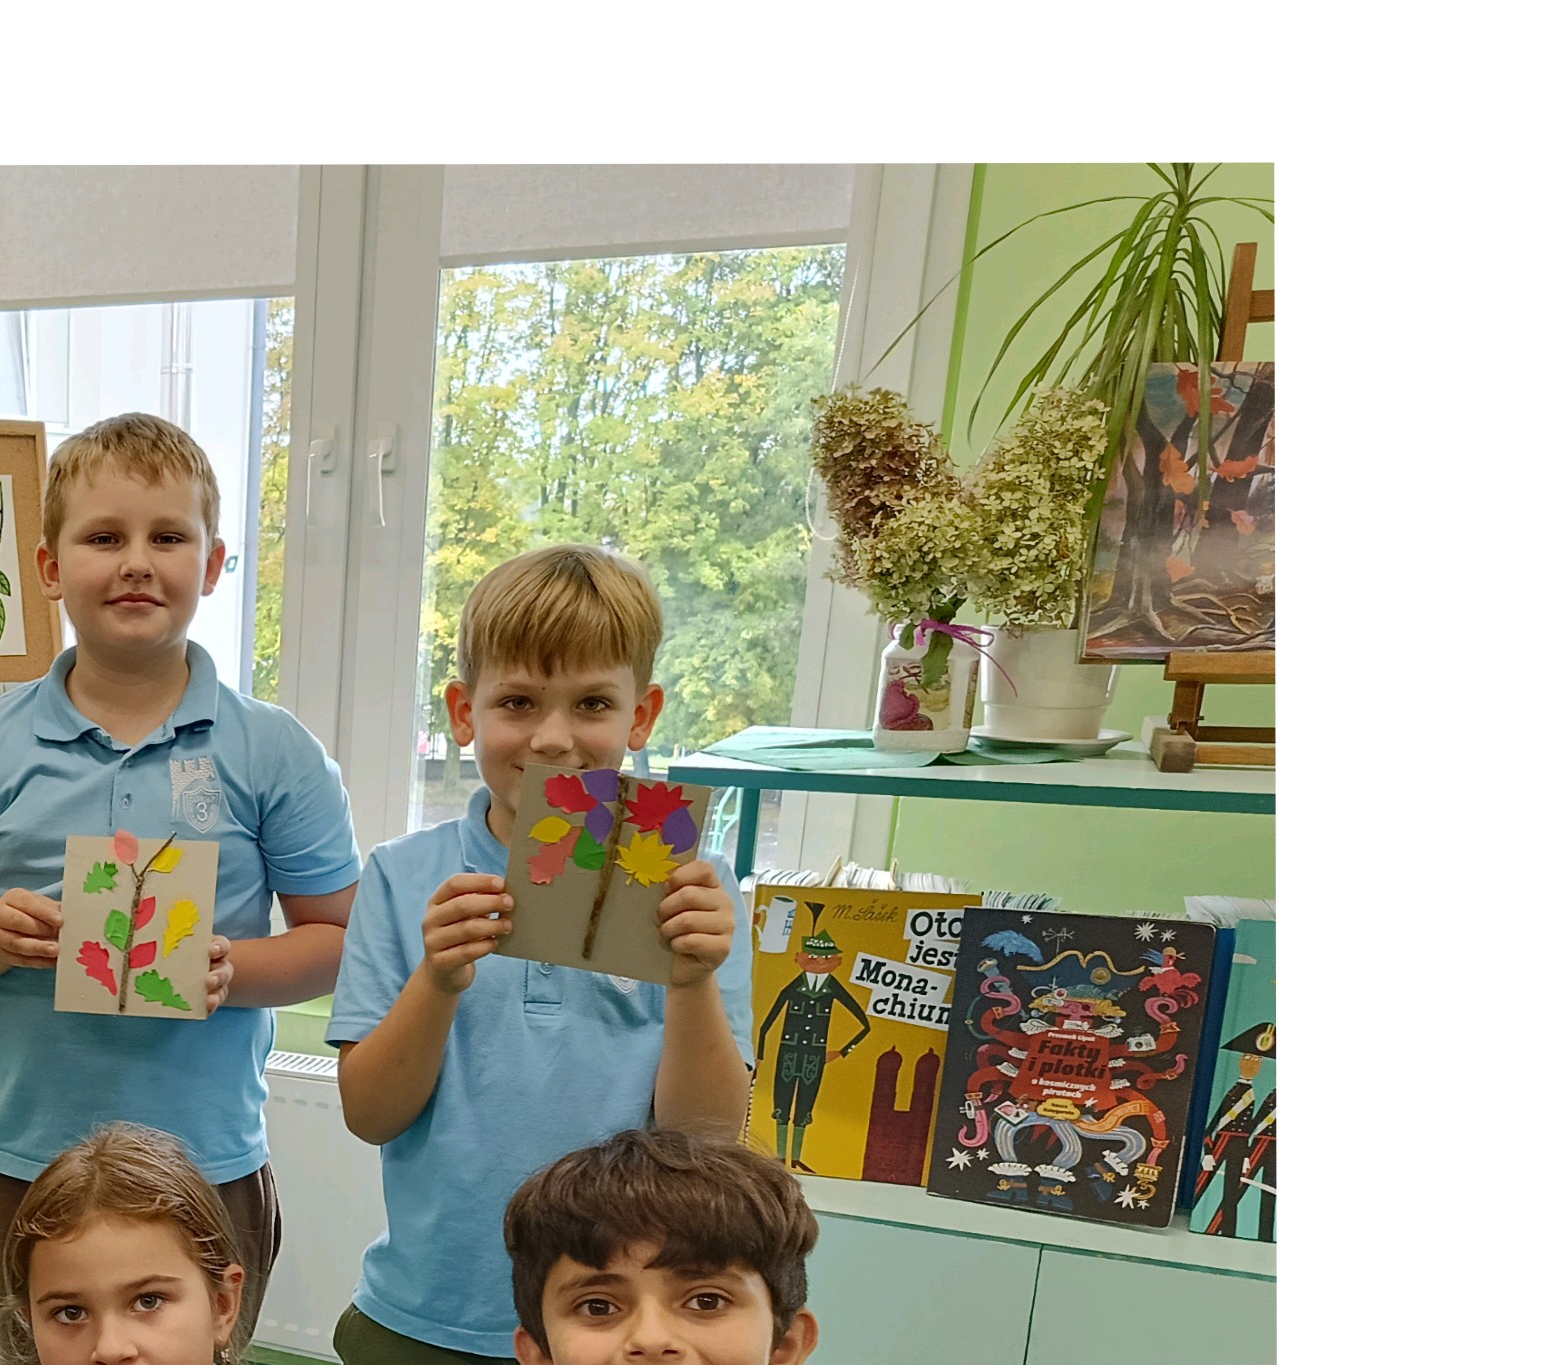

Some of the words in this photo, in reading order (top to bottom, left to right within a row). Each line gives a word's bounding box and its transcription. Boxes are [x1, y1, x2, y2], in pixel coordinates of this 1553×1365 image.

[196, 802, 208, 822] 3
[910, 911, 962, 939] Oto
[855, 958, 938, 996] Mona-
[1038, 1040, 1101, 1062] Fakty
[1028, 1057, 1037, 1072] i
[1039, 1059, 1107, 1079] plotki
[1038, 1078, 1096, 1092] kosmicznych
